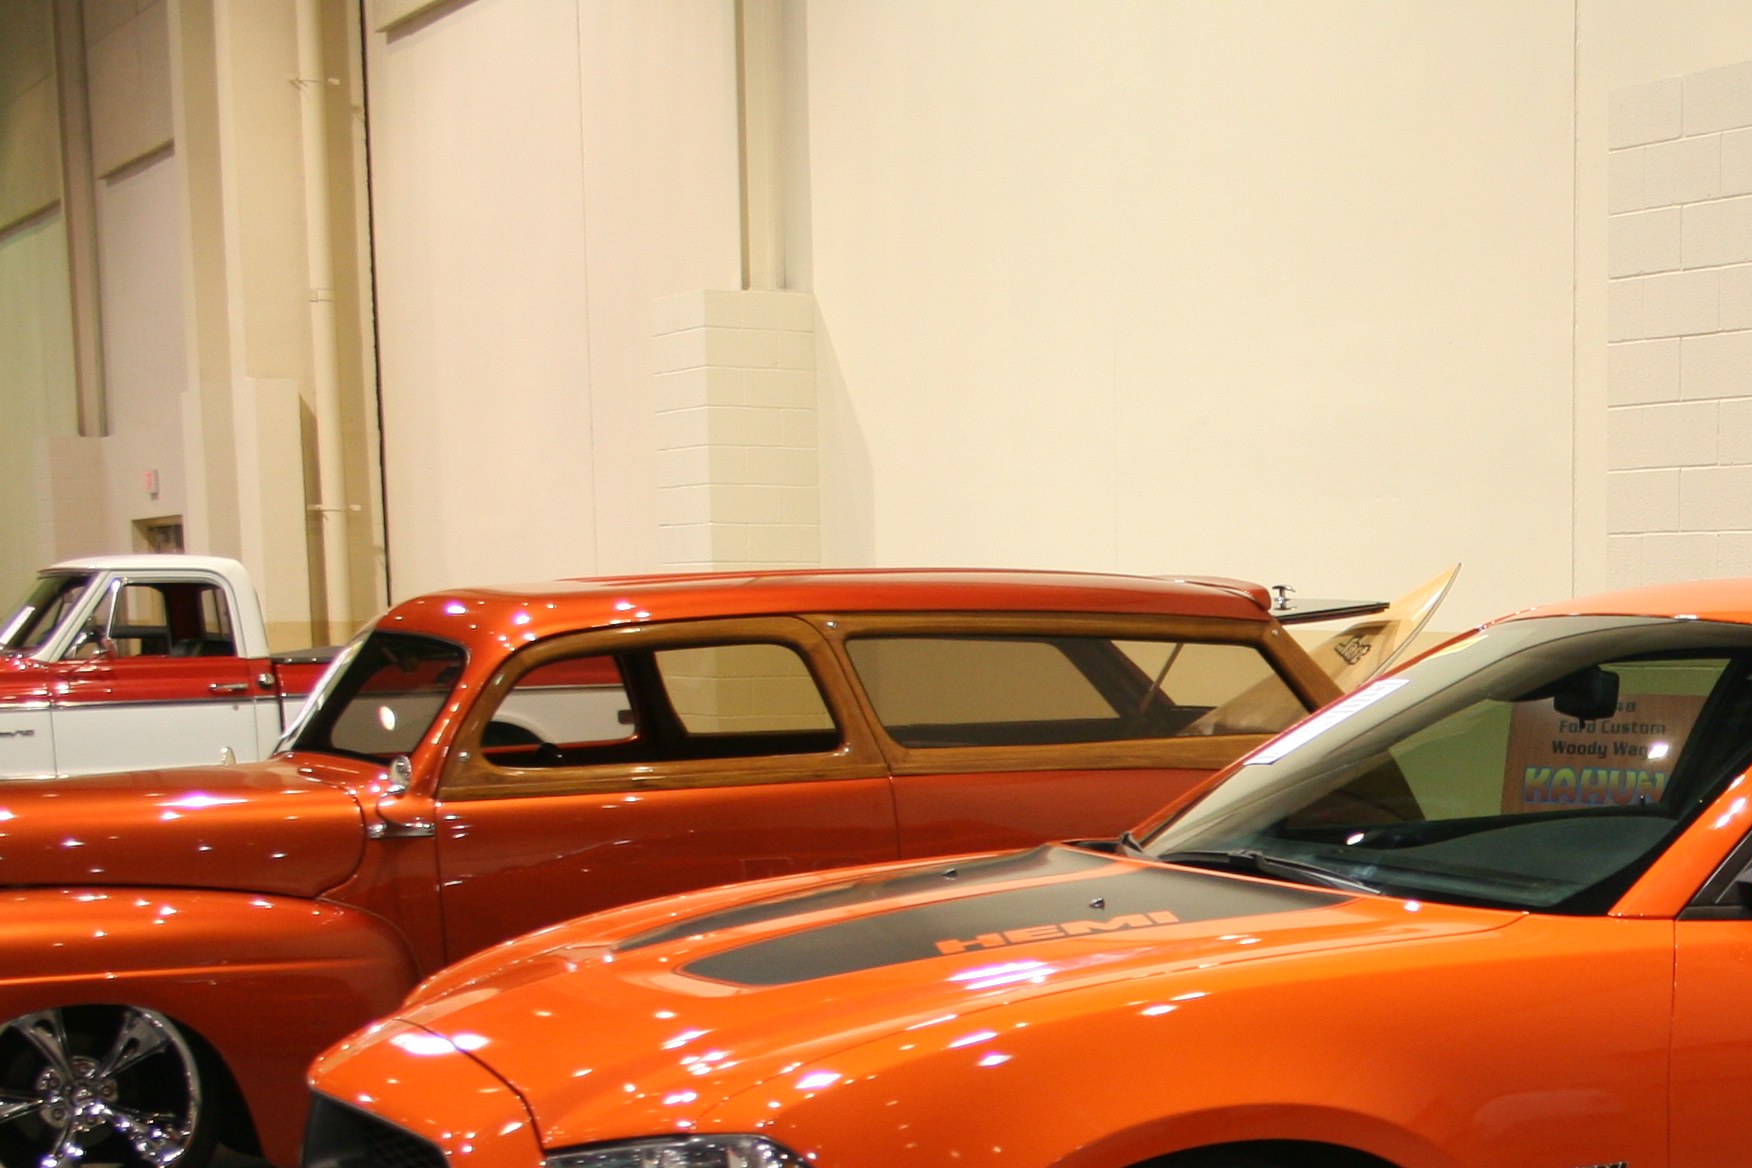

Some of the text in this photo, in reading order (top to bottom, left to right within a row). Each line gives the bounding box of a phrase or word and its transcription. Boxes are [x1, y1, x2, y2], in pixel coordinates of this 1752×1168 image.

[1559, 719, 1666, 735] Ford Custom
[1552, 740, 1607, 758] Woody
[1523, 766, 1668, 806] KAHUN
[934, 910, 1180, 955] HEMI
